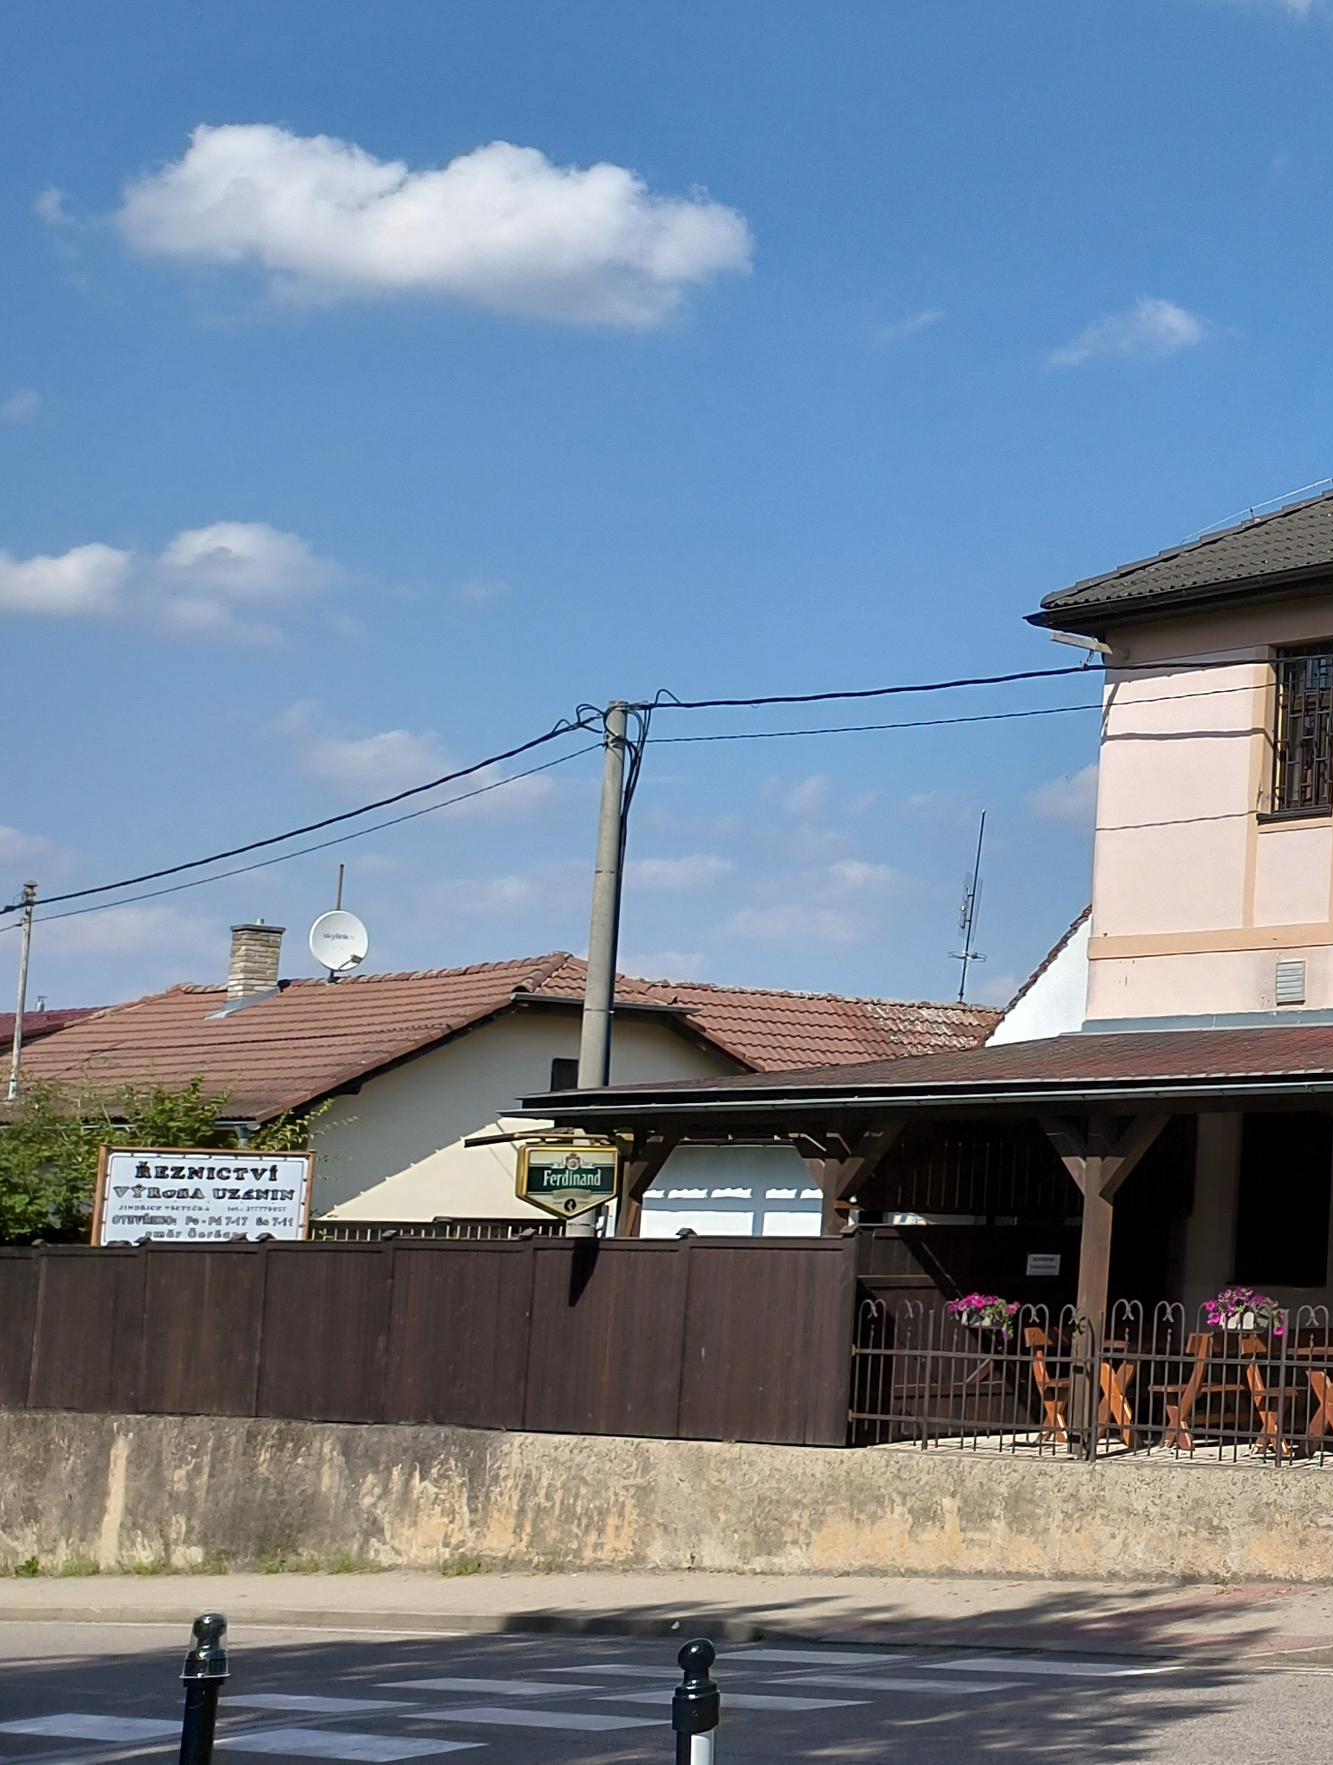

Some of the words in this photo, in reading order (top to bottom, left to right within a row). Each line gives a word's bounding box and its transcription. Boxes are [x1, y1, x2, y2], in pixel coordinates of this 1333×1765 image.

[135, 1161, 278, 1181] ŘEZNICTVÍ
[543, 1168, 602, 1187] Ferdinand
[113, 1184, 205, 1199] VÝROBA
[212, 1187, 295, 1200] UZENIN
